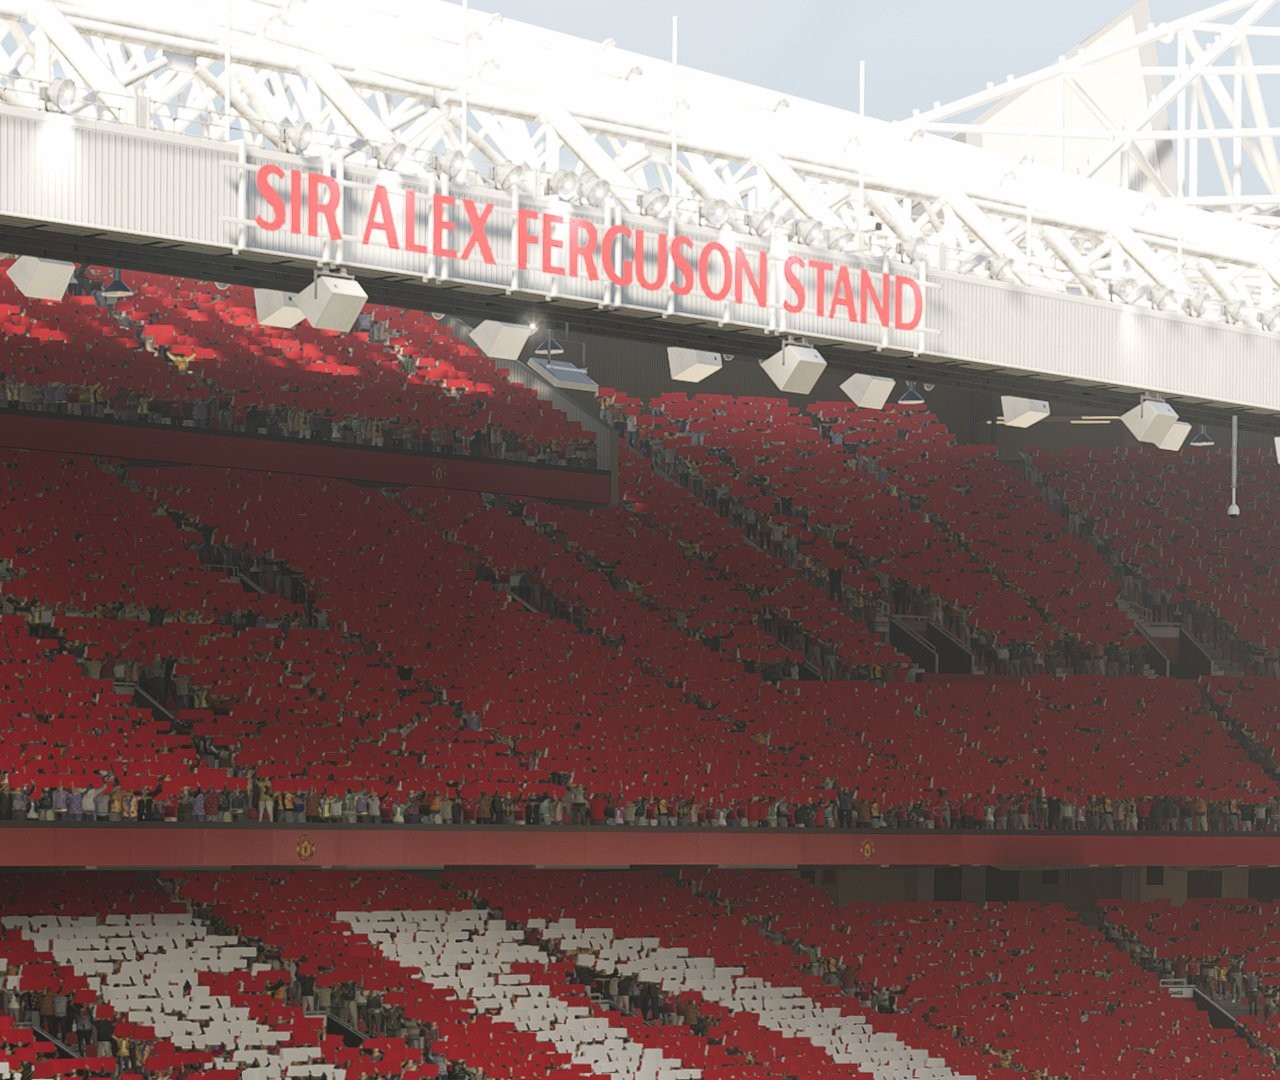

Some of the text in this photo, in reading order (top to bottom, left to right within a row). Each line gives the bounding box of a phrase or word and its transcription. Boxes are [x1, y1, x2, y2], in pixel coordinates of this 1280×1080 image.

[254, 164, 925, 332] SIR ALEX FERGUSON STAND
